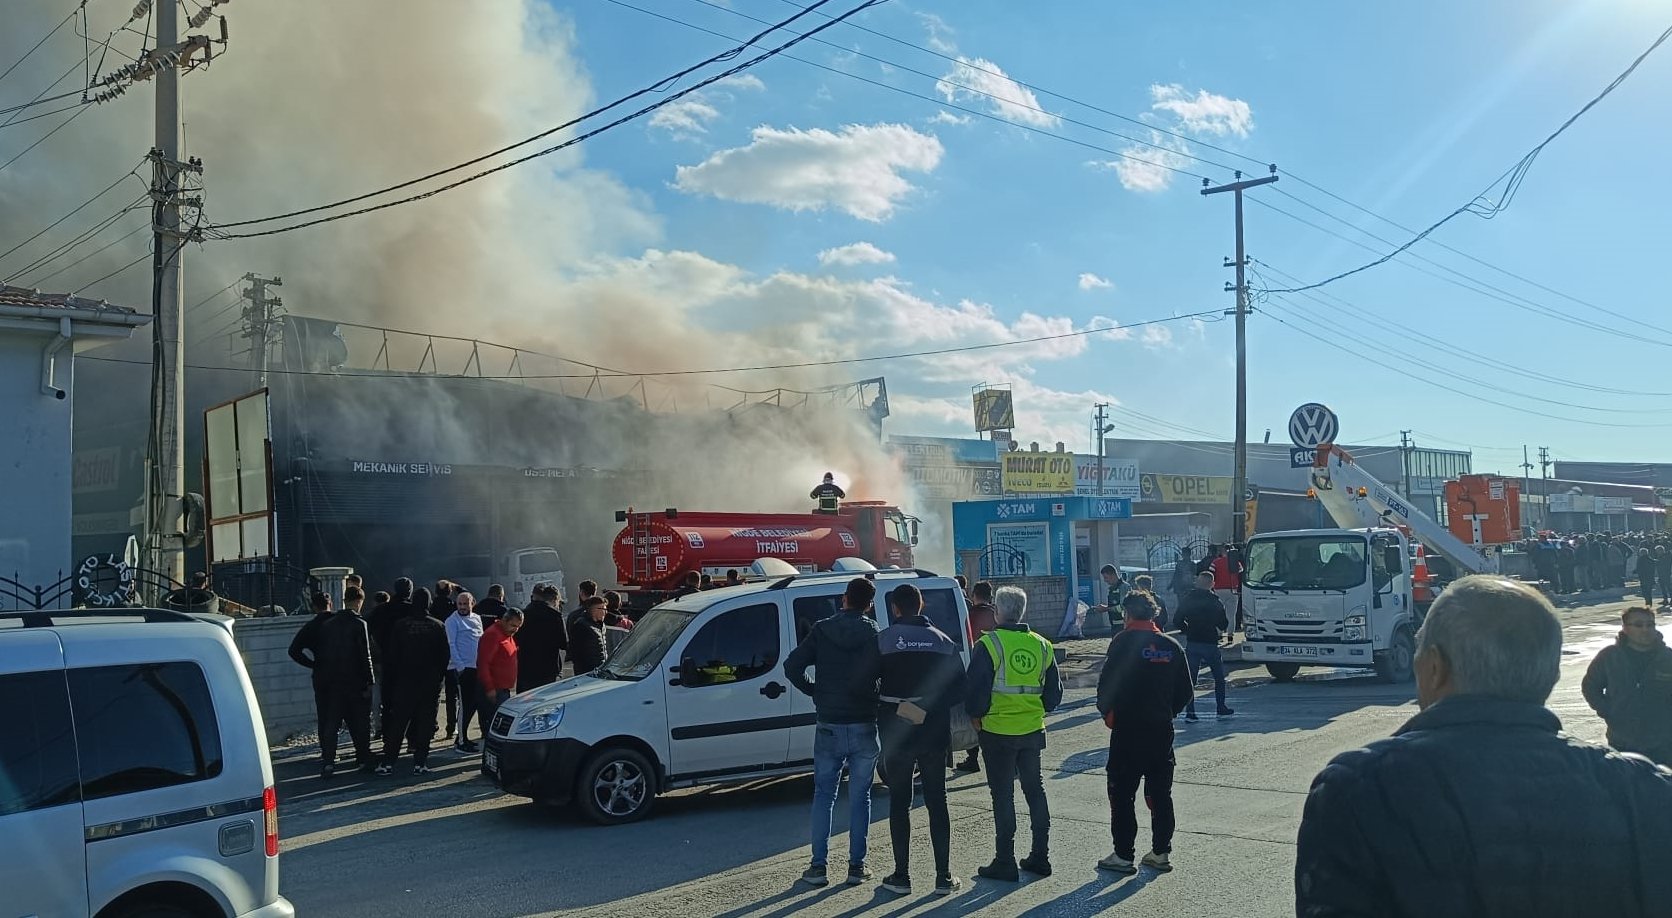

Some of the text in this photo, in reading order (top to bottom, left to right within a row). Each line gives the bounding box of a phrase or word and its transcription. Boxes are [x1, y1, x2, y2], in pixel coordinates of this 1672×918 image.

[1006, 457, 1045, 474] MURAT
[1050, 458, 1071, 474] OTO
[1172, 477, 1215, 495] OPEL
[1011, 503, 1035, 514] TAM
[1107, 501, 1121, 511] TAM
[656, 557, 666, 565] 112
[79, 556, 99, 588] OTO
